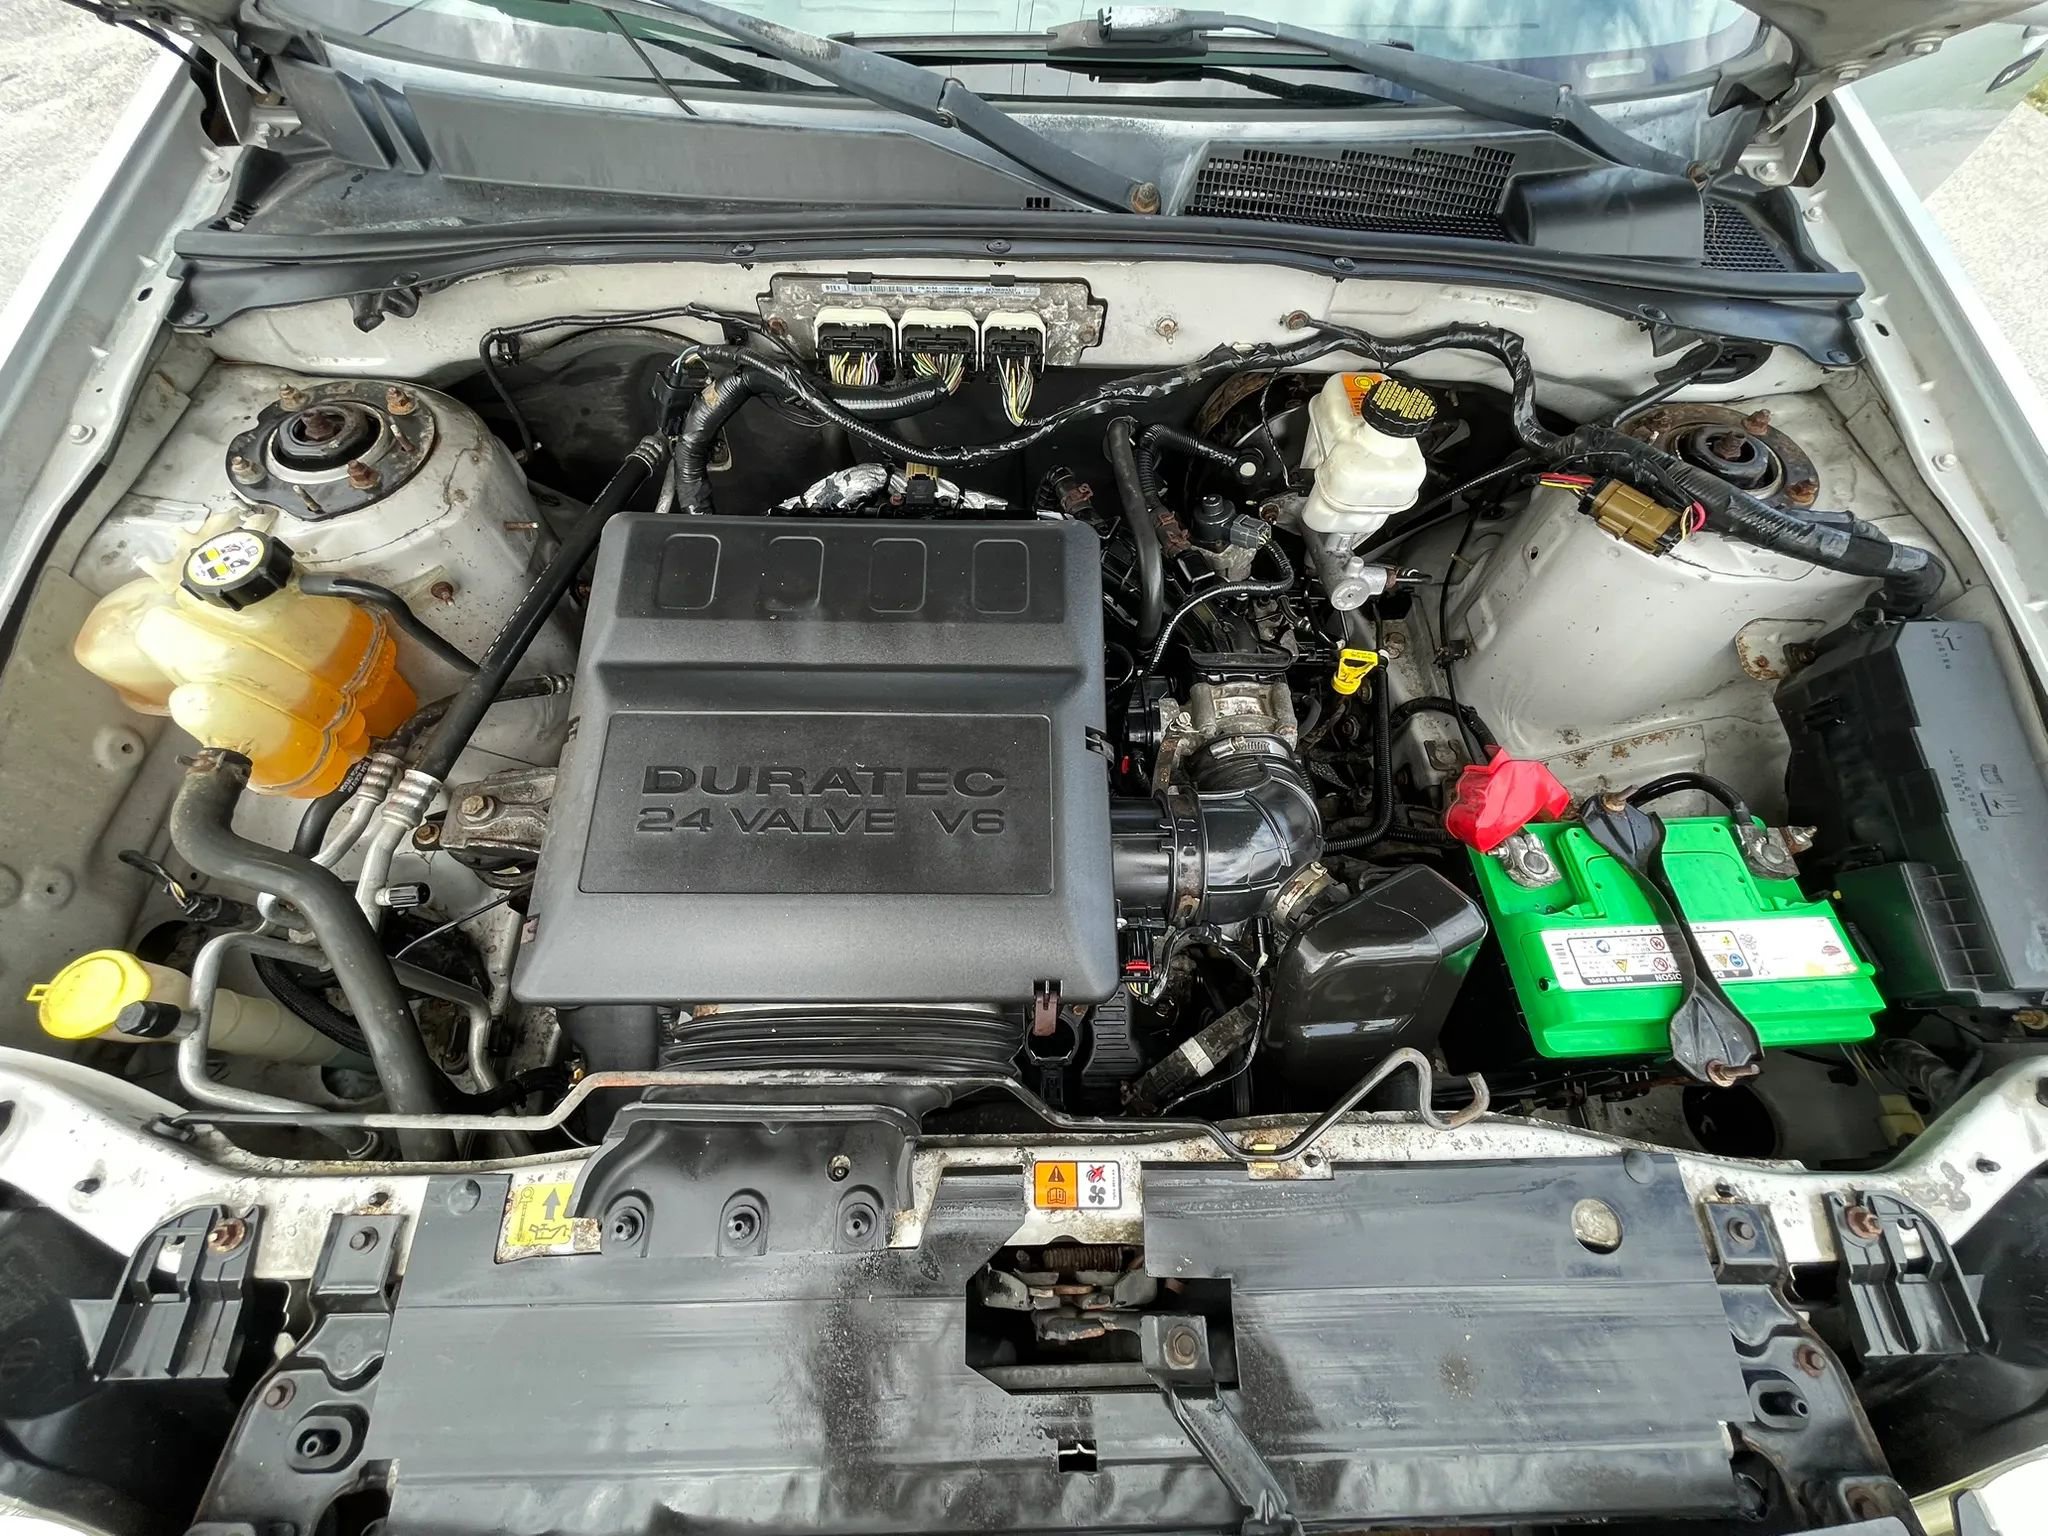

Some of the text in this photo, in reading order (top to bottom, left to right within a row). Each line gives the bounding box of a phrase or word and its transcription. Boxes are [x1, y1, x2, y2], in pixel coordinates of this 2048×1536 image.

[642, 765, 1006, 798] DURATEC
[636, 806, 1005, 836] 24 VALVE V6
[1654, 972, 1682, 983] OISON
